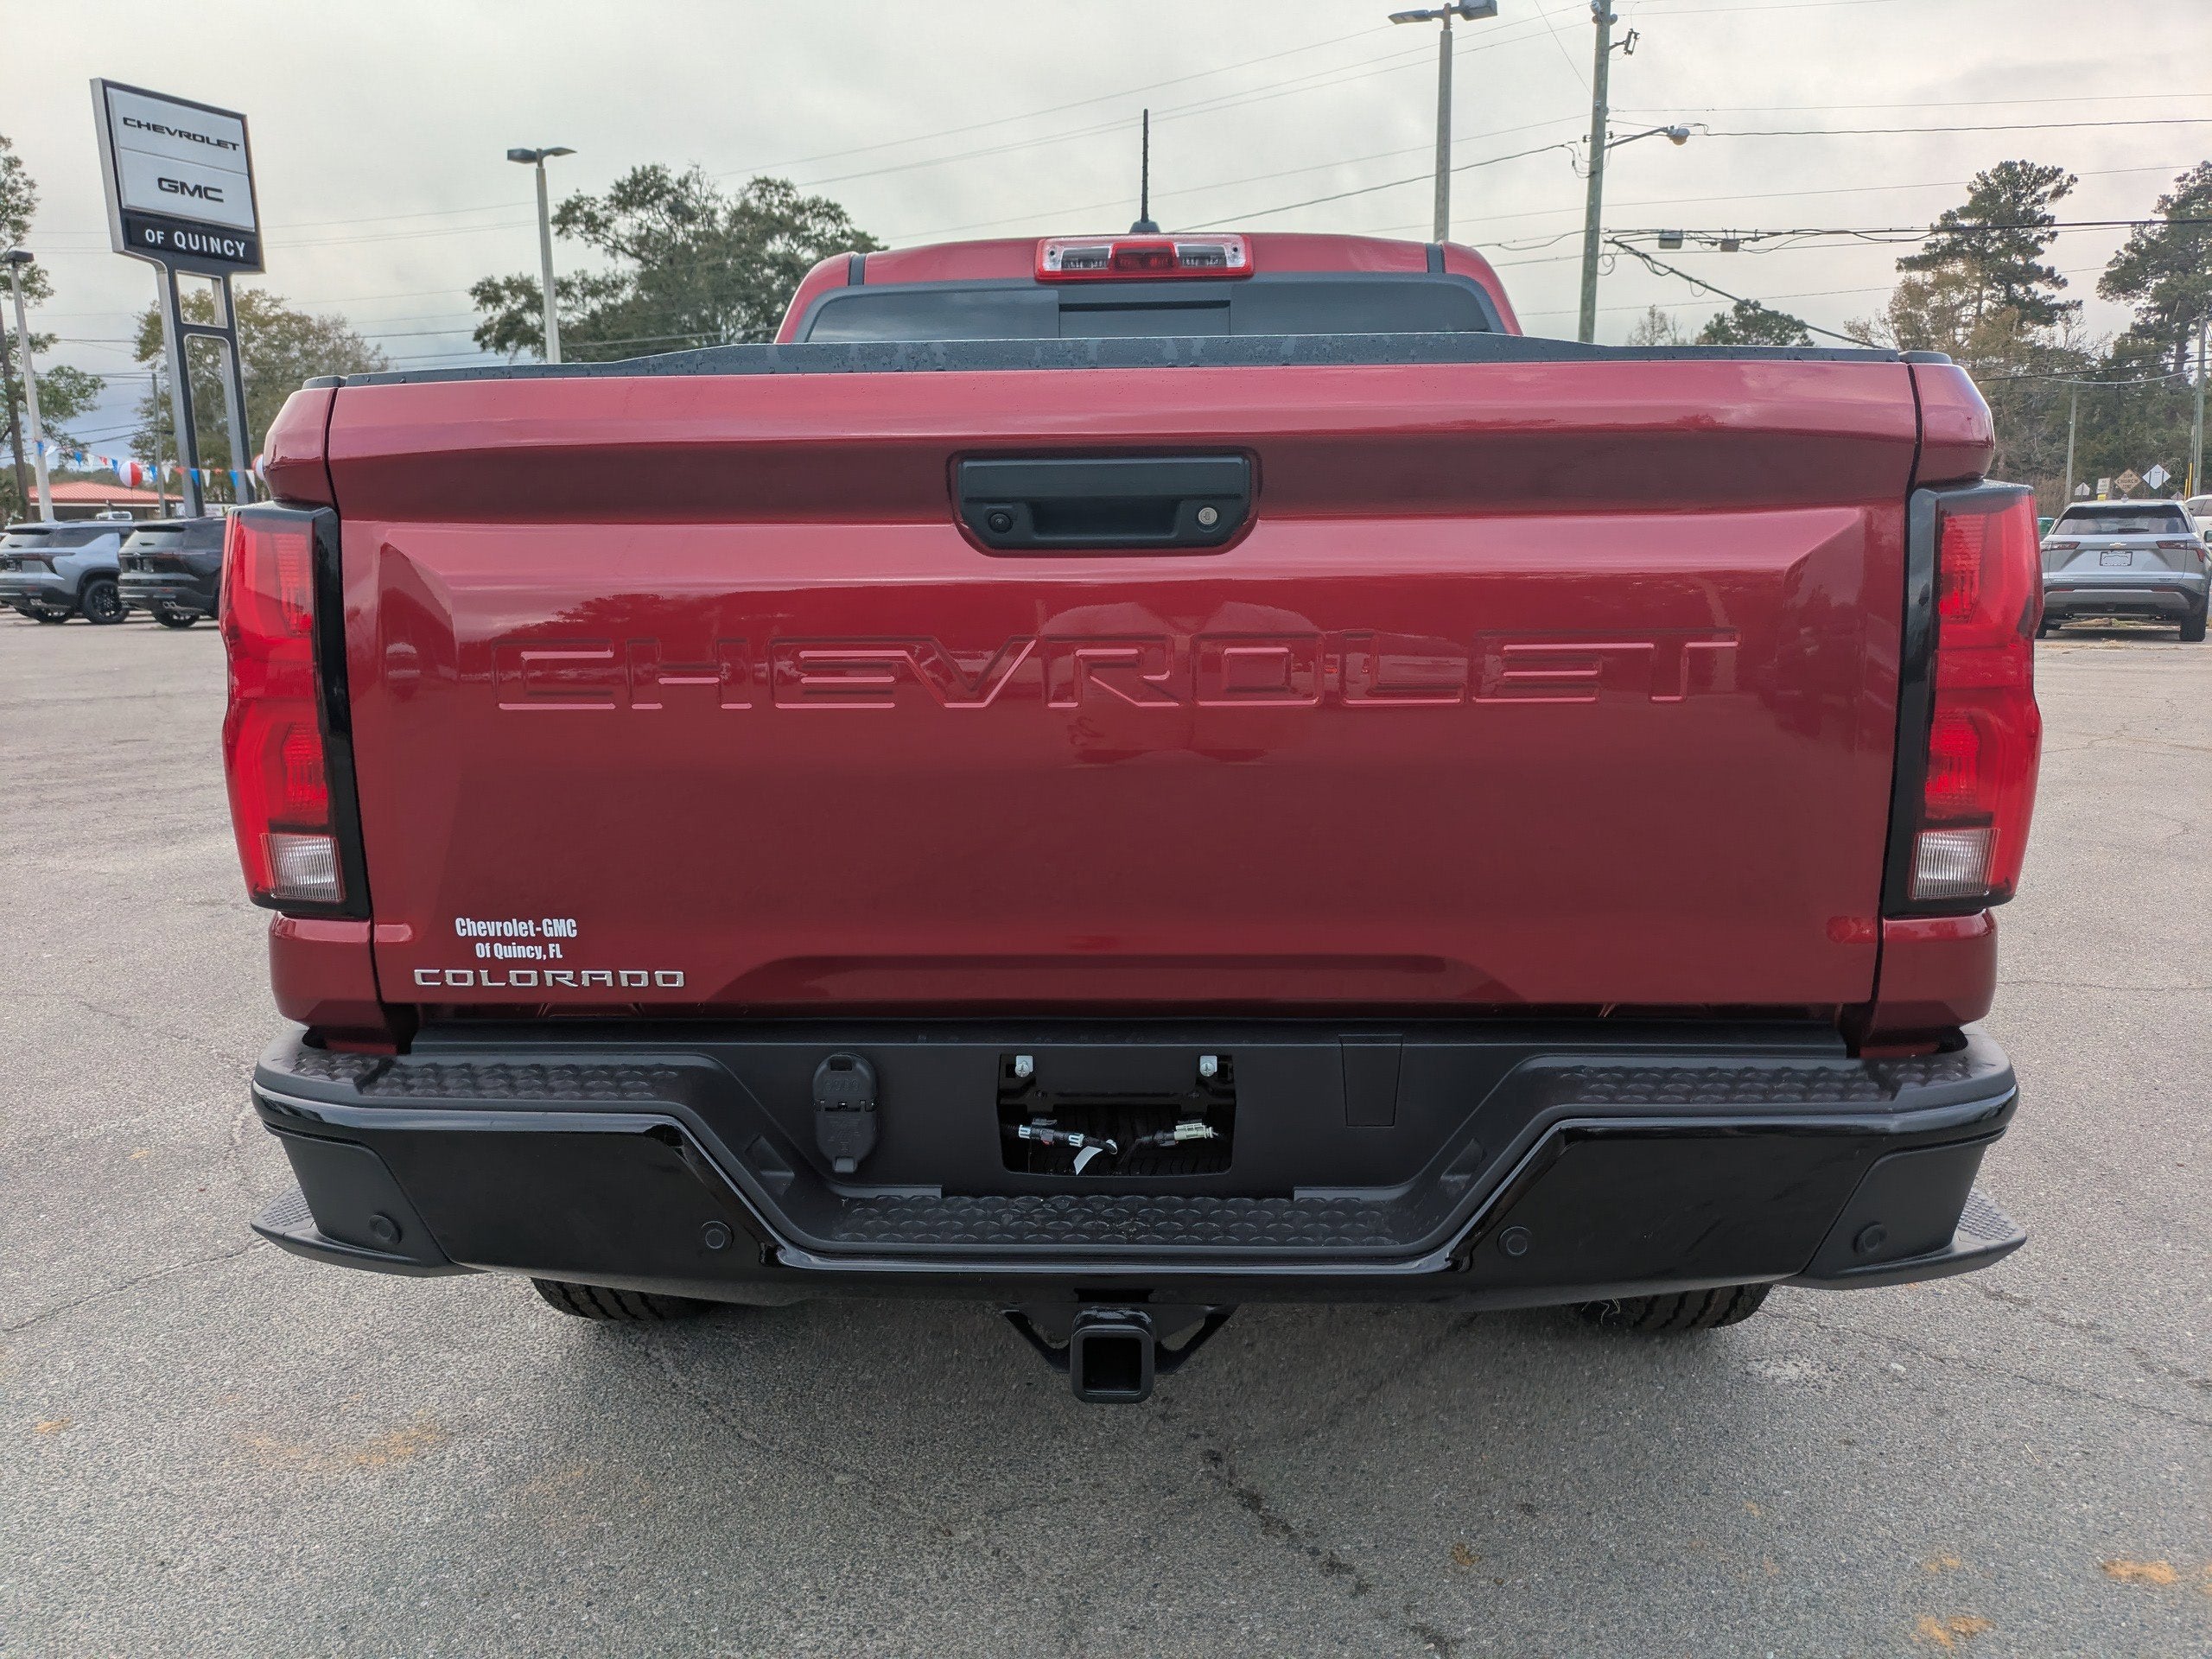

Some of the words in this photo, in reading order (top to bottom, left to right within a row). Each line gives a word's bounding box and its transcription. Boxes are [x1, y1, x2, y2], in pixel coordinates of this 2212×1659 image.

[123, 117, 239, 150] CHEVROLET
[157, 177, 224, 202] GMC
[145, 229, 164, 245] OF
[174, 231, 245, 257] QUINCY
[493, 628, 1741, 709] CHEVROLET
[454, 917, 577, 938] Chevrolet-GMC
[475, 943, 492, 958] Of
[493, 943, 546, 961] Quincy,
[549, 944, 563, 958] FL
[413, 969, 685, 987] COLORADO
